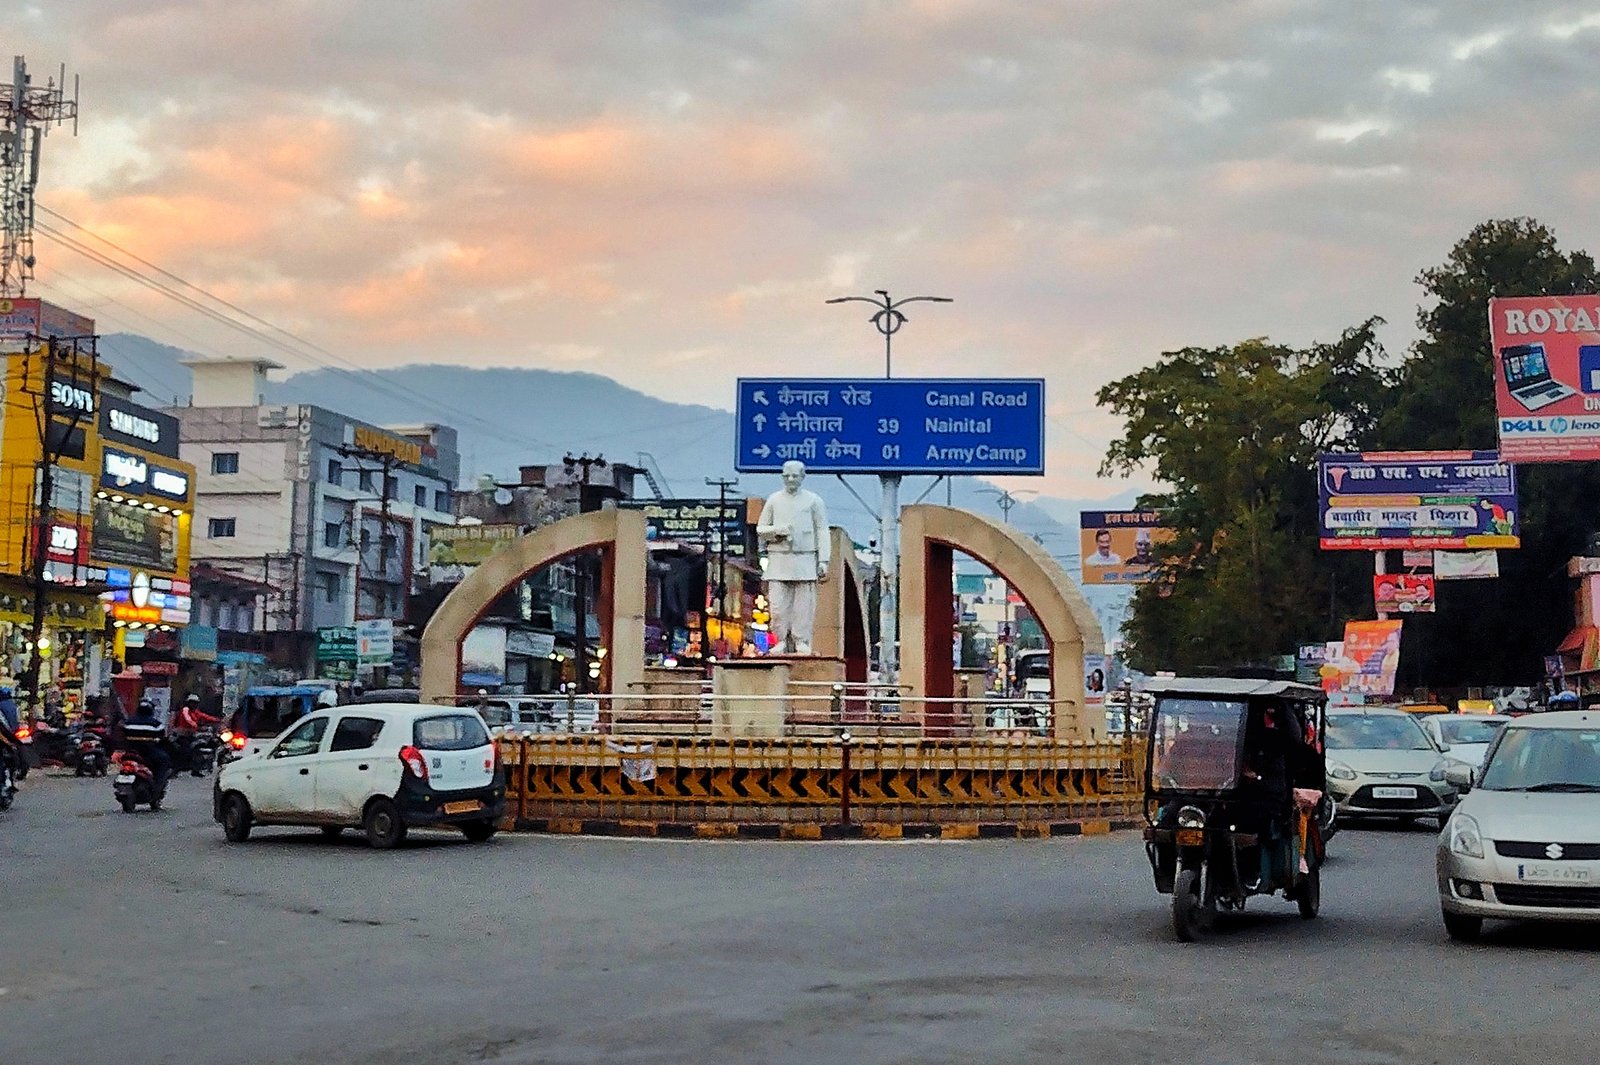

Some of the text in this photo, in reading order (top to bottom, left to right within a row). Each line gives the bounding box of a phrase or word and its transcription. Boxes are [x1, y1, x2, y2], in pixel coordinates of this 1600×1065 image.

[777, 385, 872, 406] कैनाल रोड
[926, 390, 1028, 406] Canal Road
[776, 410, 900, 434] नैनीताल 39
[925, 417, 992, 433] Nainital
[1502, 420, 1547, 433] DELL
[775, 437, 900, 460] आर्मी कैम्प 01
